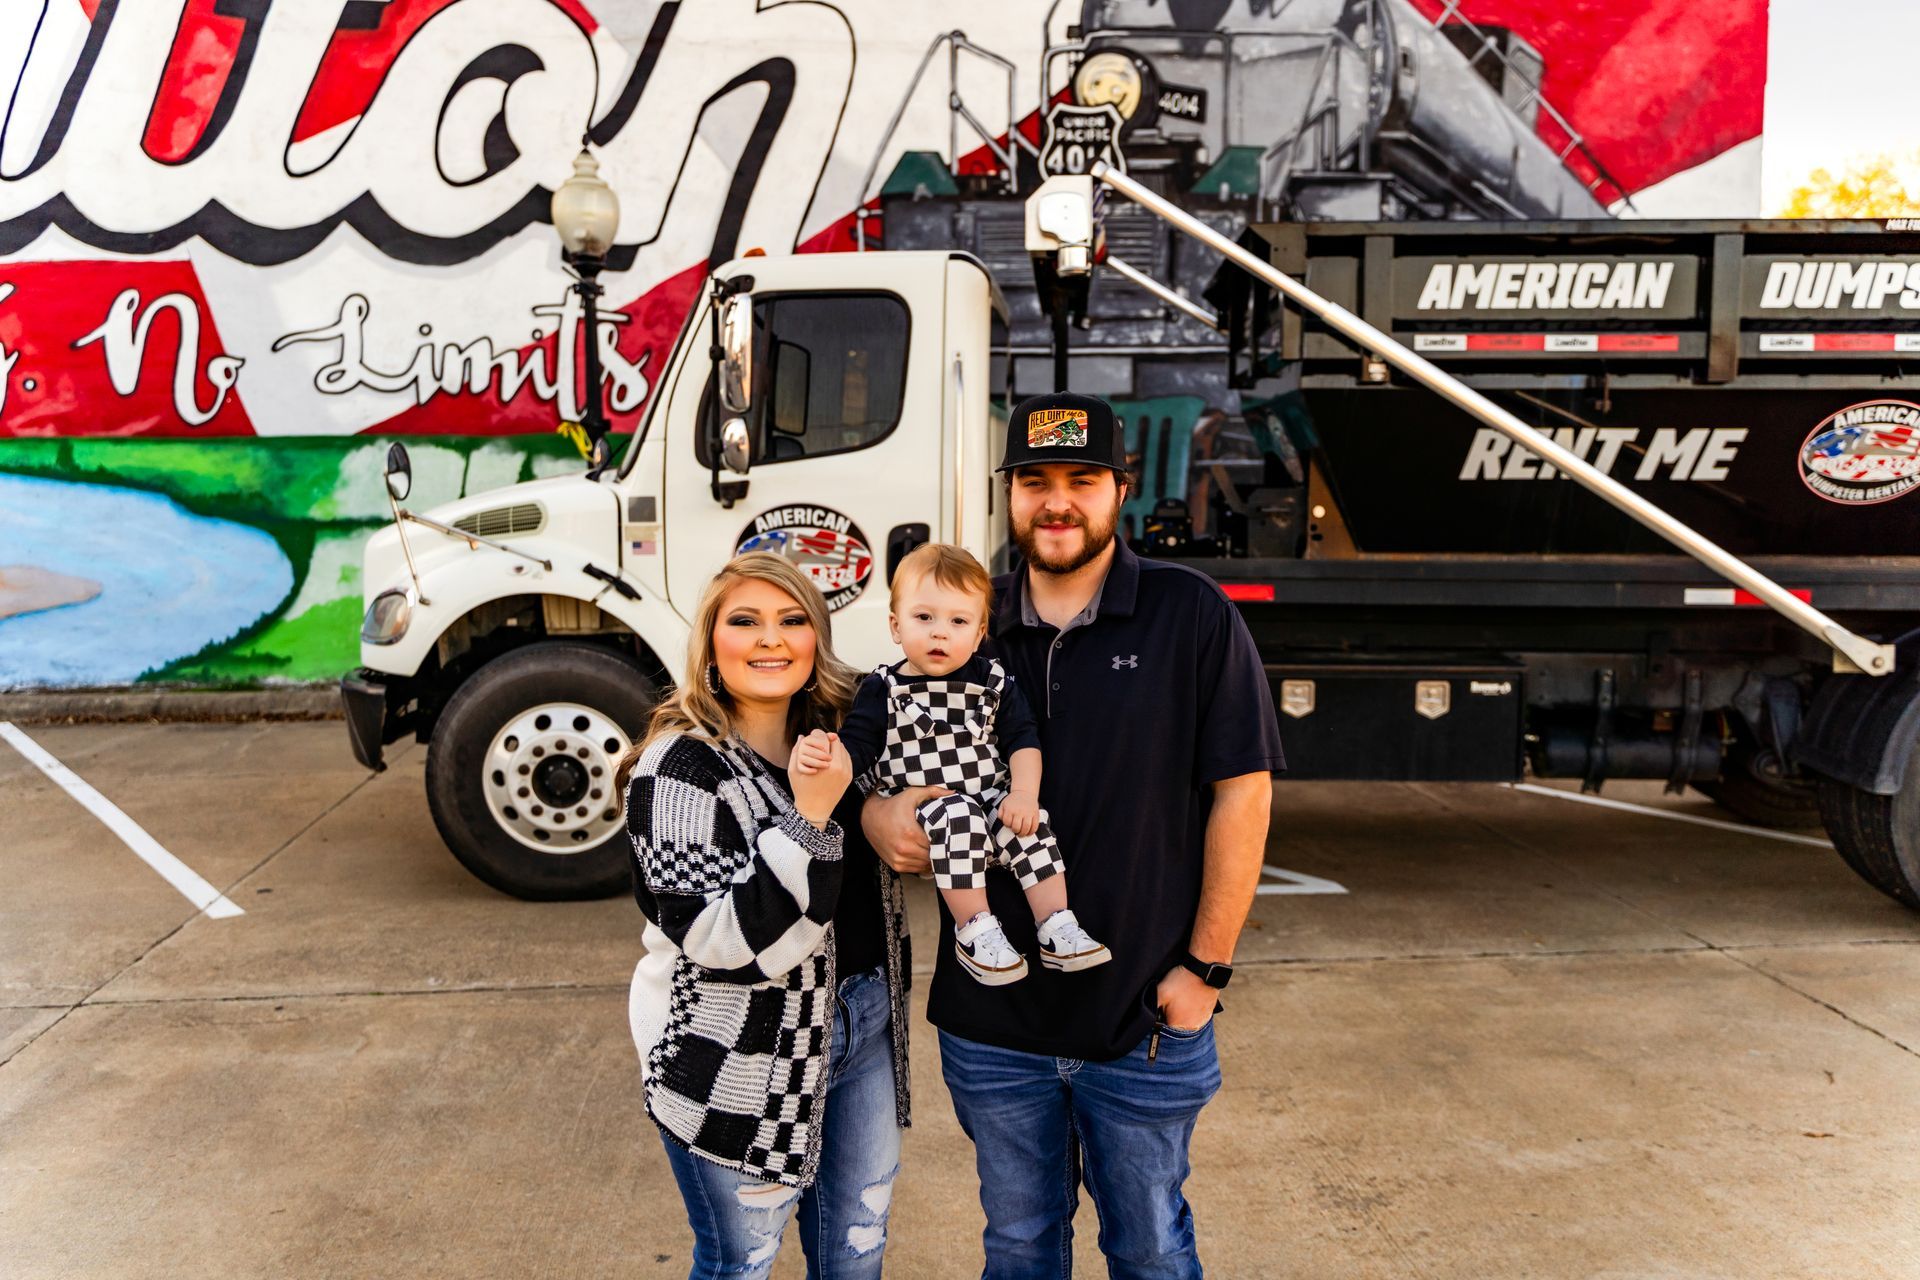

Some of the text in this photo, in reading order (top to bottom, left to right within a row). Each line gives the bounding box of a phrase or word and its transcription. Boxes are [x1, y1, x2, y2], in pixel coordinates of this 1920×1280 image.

[1158, 92, 1199, 116] 4014
[1055, 127, 1111, 143] PACIFIC
[1063, 116, 1106, 128] UNION
[1417, 262, 1674, 310] AMERICAN
[270, 282, 651, 424] Limits
[1030, 411, 1046, 431] RED
[1047, 410, 1066, 421] DIRT
[1458, 427, 1749, 481] RENT ME
[1806, 471, 1866, 500] DUMPSTER
[755, 507, 850, 534] AMERICAN
